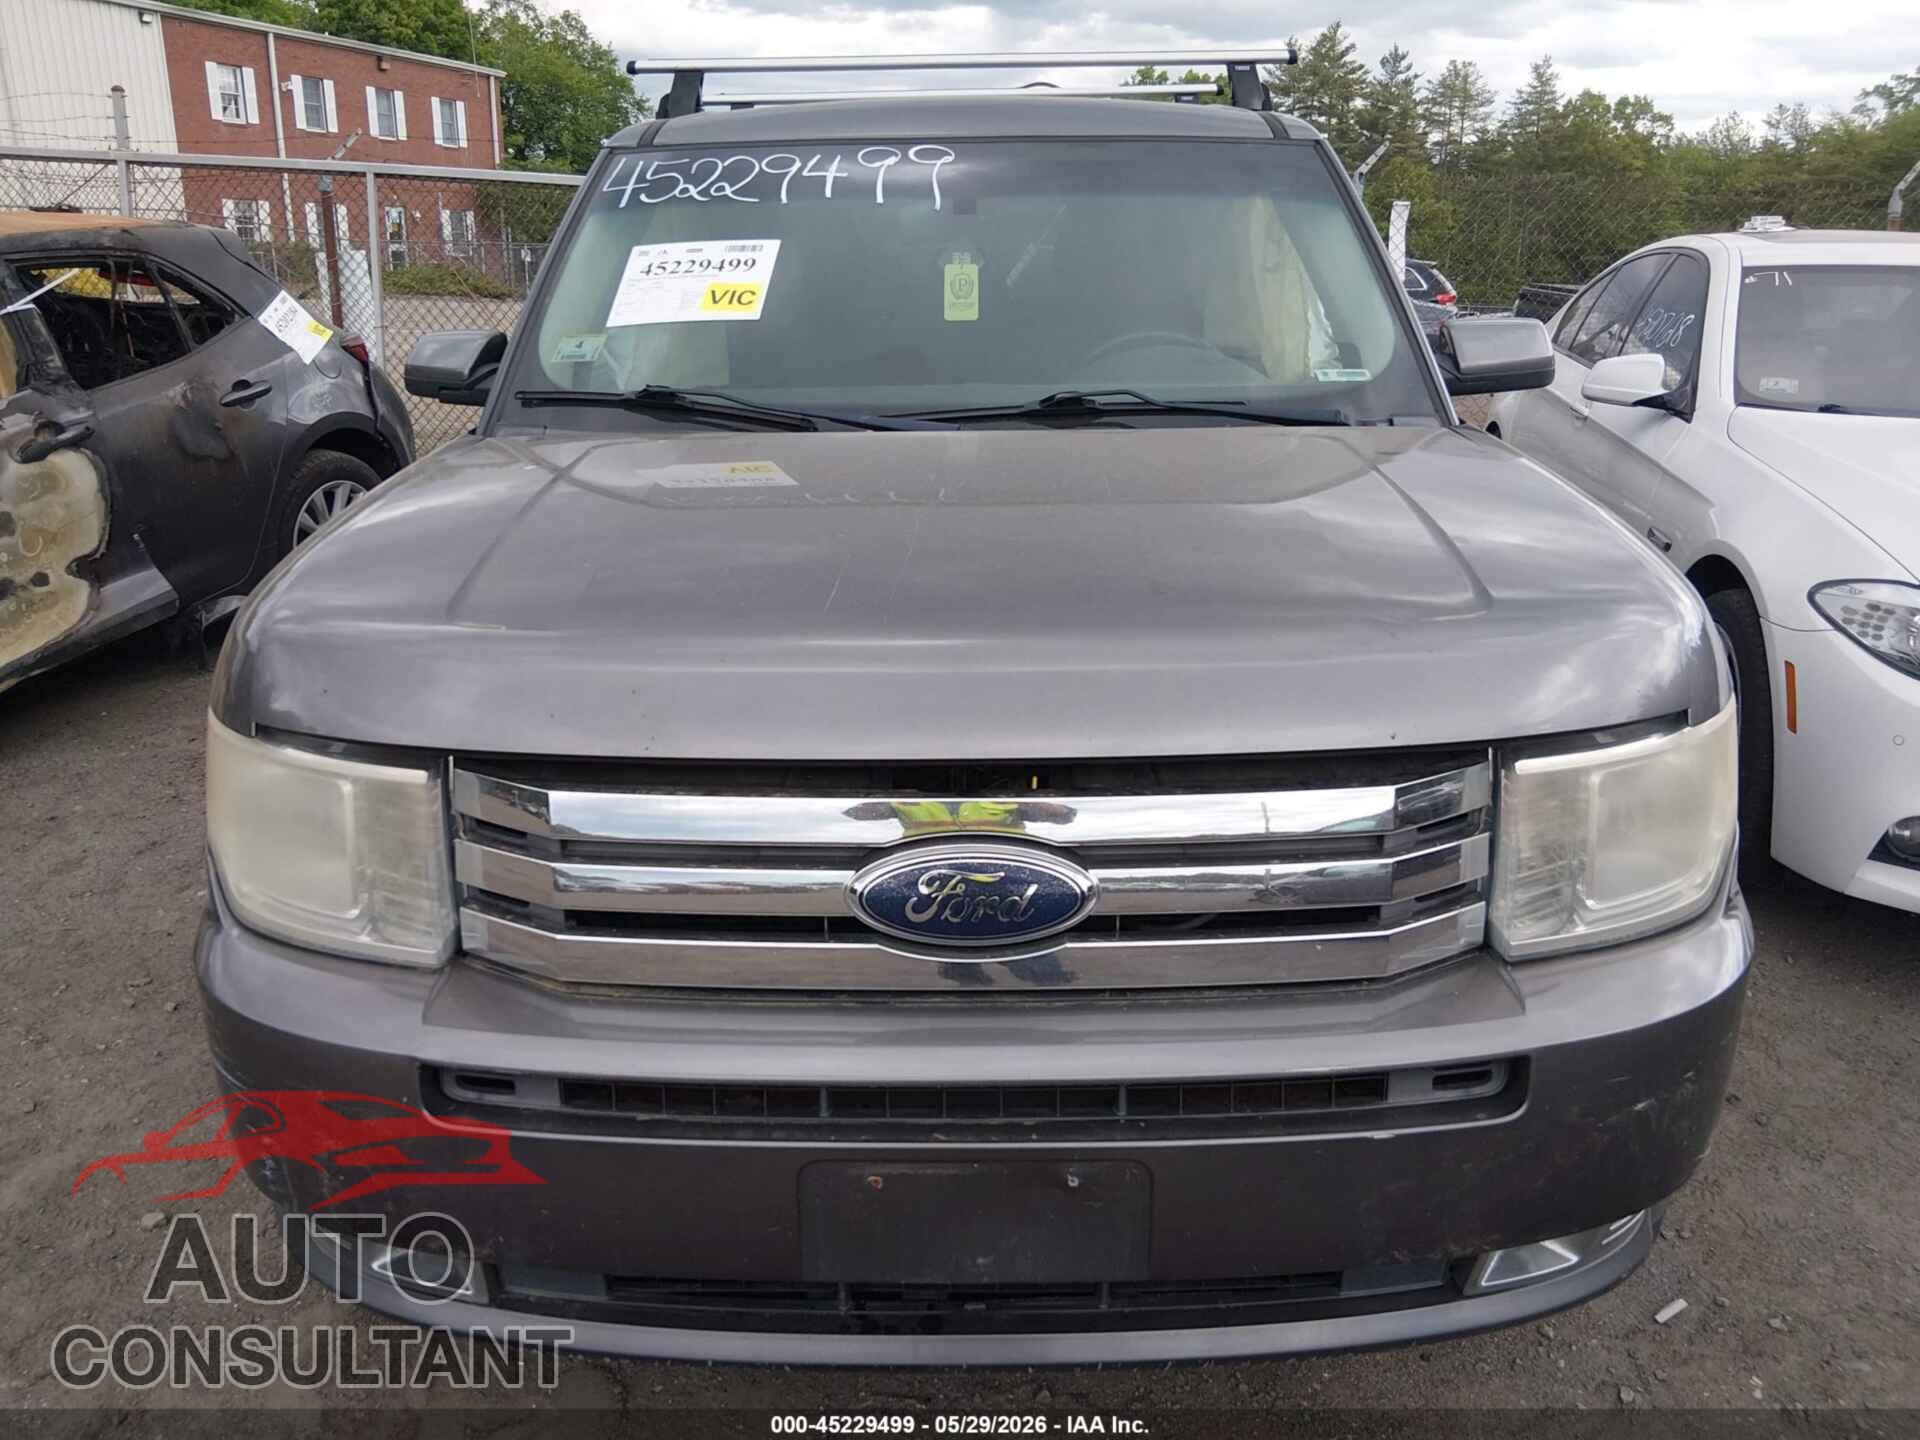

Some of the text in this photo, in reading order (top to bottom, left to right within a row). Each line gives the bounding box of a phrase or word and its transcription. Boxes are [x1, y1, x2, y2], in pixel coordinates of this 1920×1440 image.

[603, 145, 955, 210] 45229499
[640, 258, 757, 276] 45229499
[710, 289, 757, 306] VIC
[904, 869, 1039, 924] Ford
